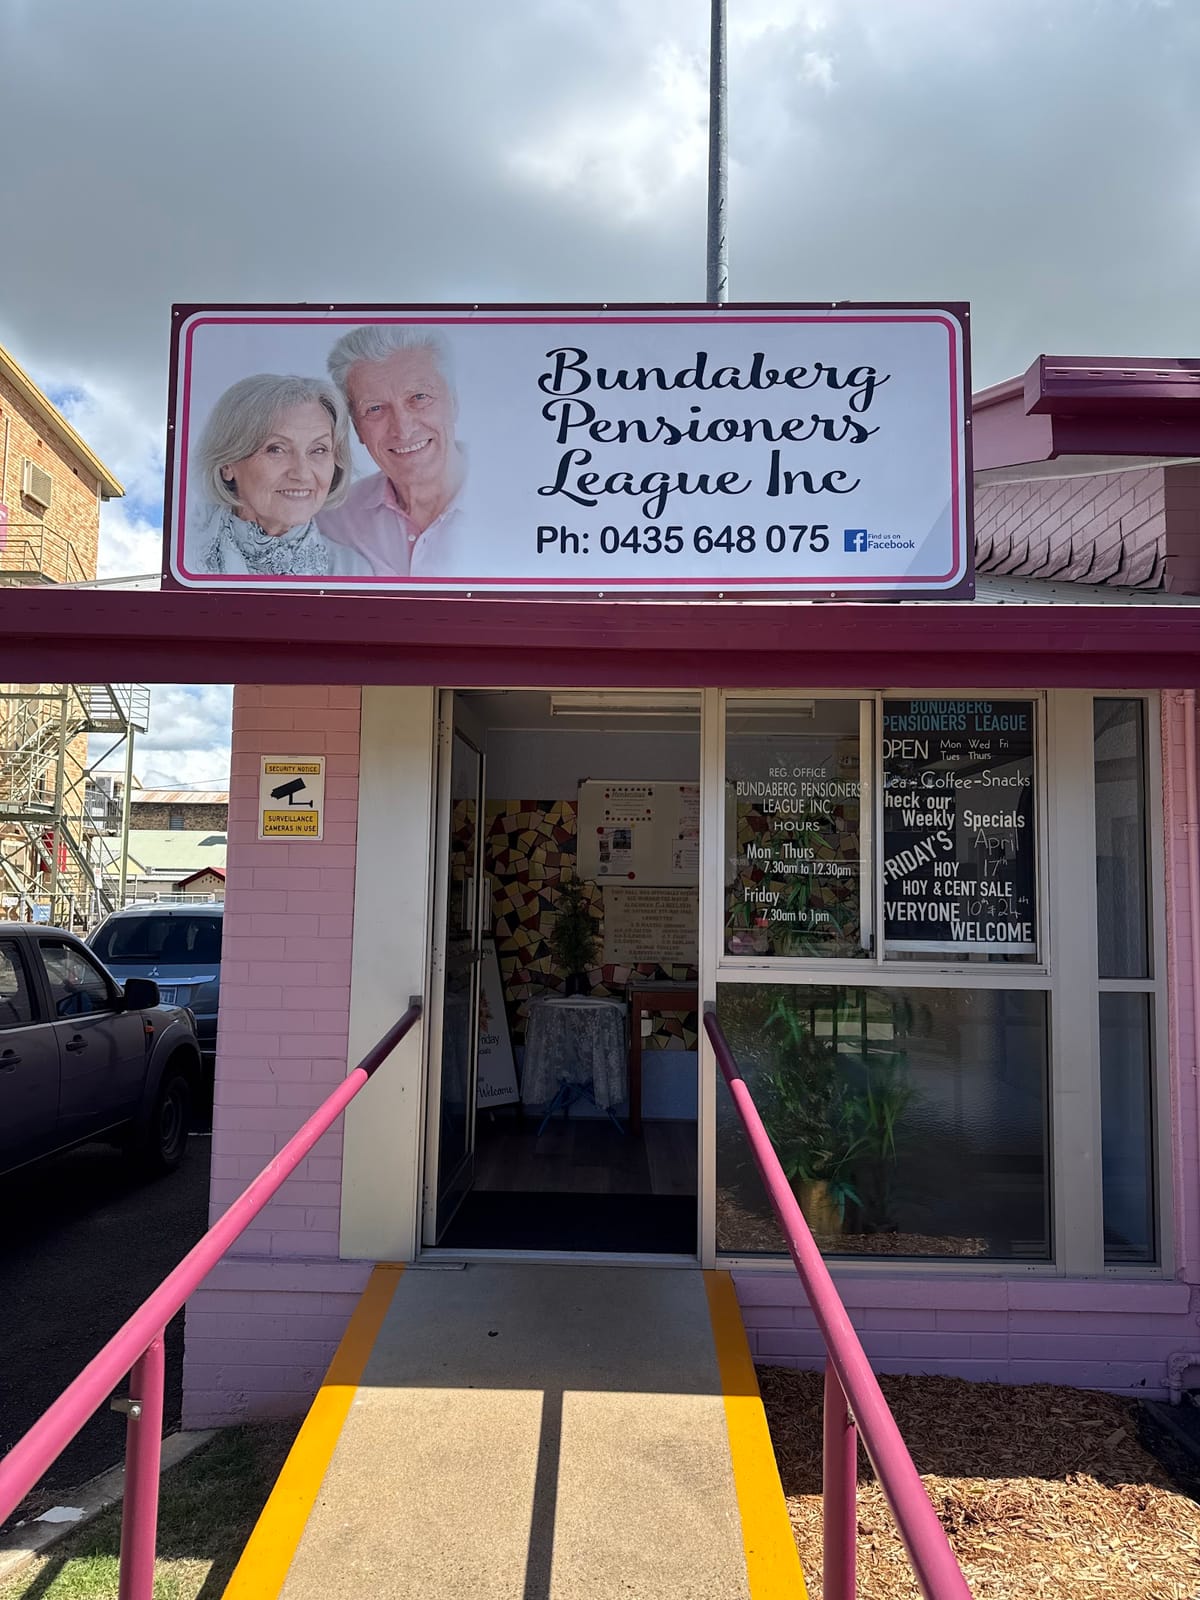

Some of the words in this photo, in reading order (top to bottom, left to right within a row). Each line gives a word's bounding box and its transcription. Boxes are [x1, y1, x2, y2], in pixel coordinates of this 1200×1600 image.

[538, 347, 891, 413] Bundaberg
[542, 397, 881, 445] Pensioners
[537, 448, 752, 519] League
[766, 449, 861, 497] Inc
[537, 526, 589, 554] Ph:
[600, 525, 684, 554] 0435
[694, 525, 756, 553] 648
[766, 525, 830, 553] 075
[868, 540, 915, 549] Facebook
[910, 701, 992, 714] BUNDABERG
[975, 715, 1027, 731] LEAGUE
[940, 739, 961, 749] Mon
[968, 739, 990, 749] Wed
[1000, 739, 1008, 748] Fri
[940, 751, 960, 761] Tues
[968, 751, 991, 760] Thurs
[769, 768, 790, 778] REG.
[793, 767, 826, 778] OFFICE
[736, 782, 797, 797] BUNDABERG
[801, 782, 862, 798] PENSIONERS
[763, 799, 805, 814] LEAGUE
[810, 799, 834, 814] INC.
[884, 790, 920, 808] heck
[927, 796, 952, 810] our
[774, 821, 820, 832] HOURS
[902, 809, 955, 830] Weekly
[963, 810, 1025, 832] Specials
[974, 828, 1019, 855] April
[747, 844, 771, 859] Mon
[783, 842, 815, 859] Thurs
[764, 861, 798, 874] 7.30am
[801, 862, 809, 874] to
[813, 862, 851, 878] 12.30pm
[934, 862, 959, 877] HOY
[744, 886, 780, 907] Friday
[902, 880, 928, 896] HOY
[933, 882, 942, 896] &
[945, 881, 977, 896] CENT
[980, 881, 1012, 897] SALE
[762, 909, 796, 921] 7.30am
[799, 910, 807, 922] to
[811, 909, 830, 924] 1pm
[884, 901, 960, 922] VERYONE
[950, 921, 1032, 942] WELCOME
